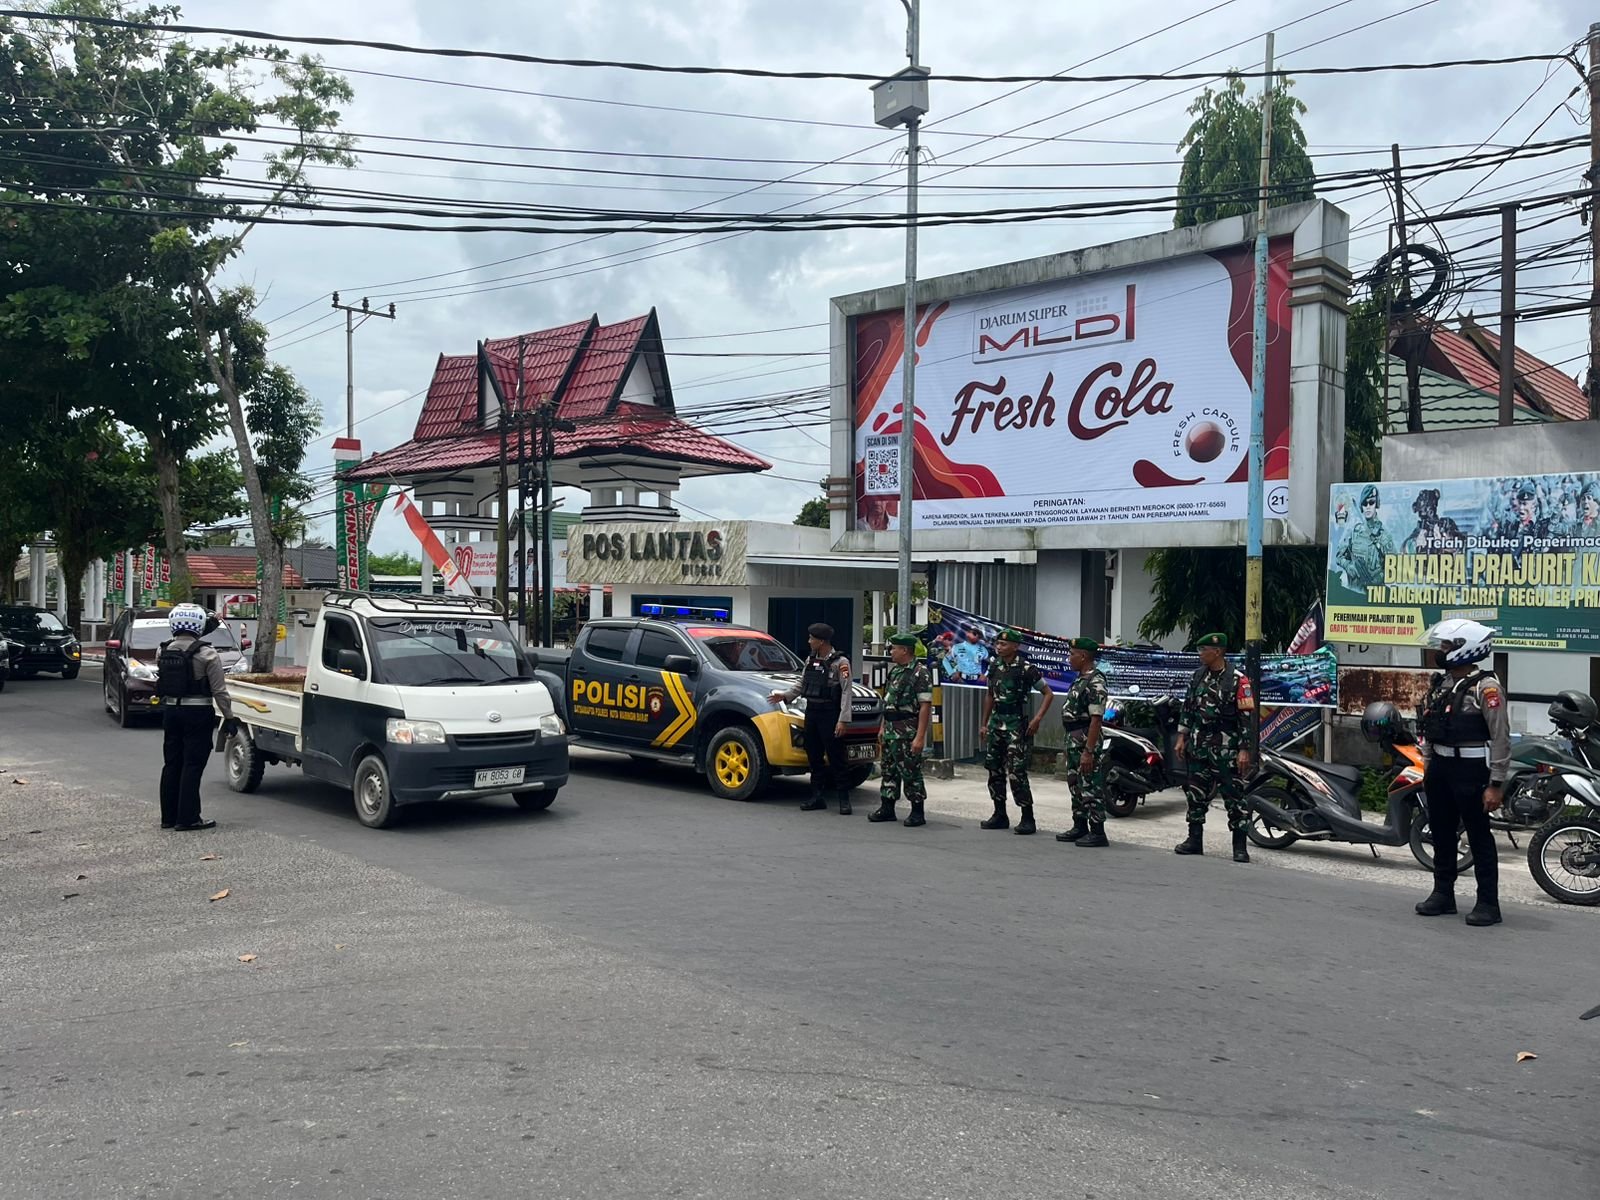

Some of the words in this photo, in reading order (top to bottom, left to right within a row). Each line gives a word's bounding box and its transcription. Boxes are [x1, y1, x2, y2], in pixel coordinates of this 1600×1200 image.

[980, 312, 1026, 330] DJARUM
[1028, 305, 1067, 322] SUPER
[941, 371, 1056, 446] Fresh
[1068, 358, 1174, 440] Cola
[867, 438, 880, 447] SCAN
[1173, 412, 1196, 456] FRESH
[1202, 408, 1240, 452] CAPSULE
[1034, 499, 1085, 507] PERINGATAN:
[343, 490, 359, 591] PERTANIAN
[583, 533, 625, 561] POS
[630, 530, 723, 561] LANTAS
[1426, 536, 1462, 548] Telah
[1466, 536, 1518, 548] Dibuka
[338, 564, 347, 592] INAS
[1384, 554, 1466, 584] BINTARA
[1472, 552, 1575, 585] PRAJURIT
[1367, 586, 1386, 603] TNI
[1389, 586, 1457, 605] ANGKATAN
[1461, 587, 1504, 606] DARAT
[1508, 588, 1571, 608] REGULER
[1575, 588, 1600, 608] PRI
[1330, 624, 1348, 633] GRATIS
[1334, 613, 1367, 622] PENERIMAAN
[1368, 614, 1394, 623] PRAJURIT
[1396, 615, 1405, 623] TNI
[1406, 615, 1414, 624] AD
[573, 679, 646, 709] POLISI
[478, 773, 487, 781] KH
[490, 771, 508, 780] 8053
